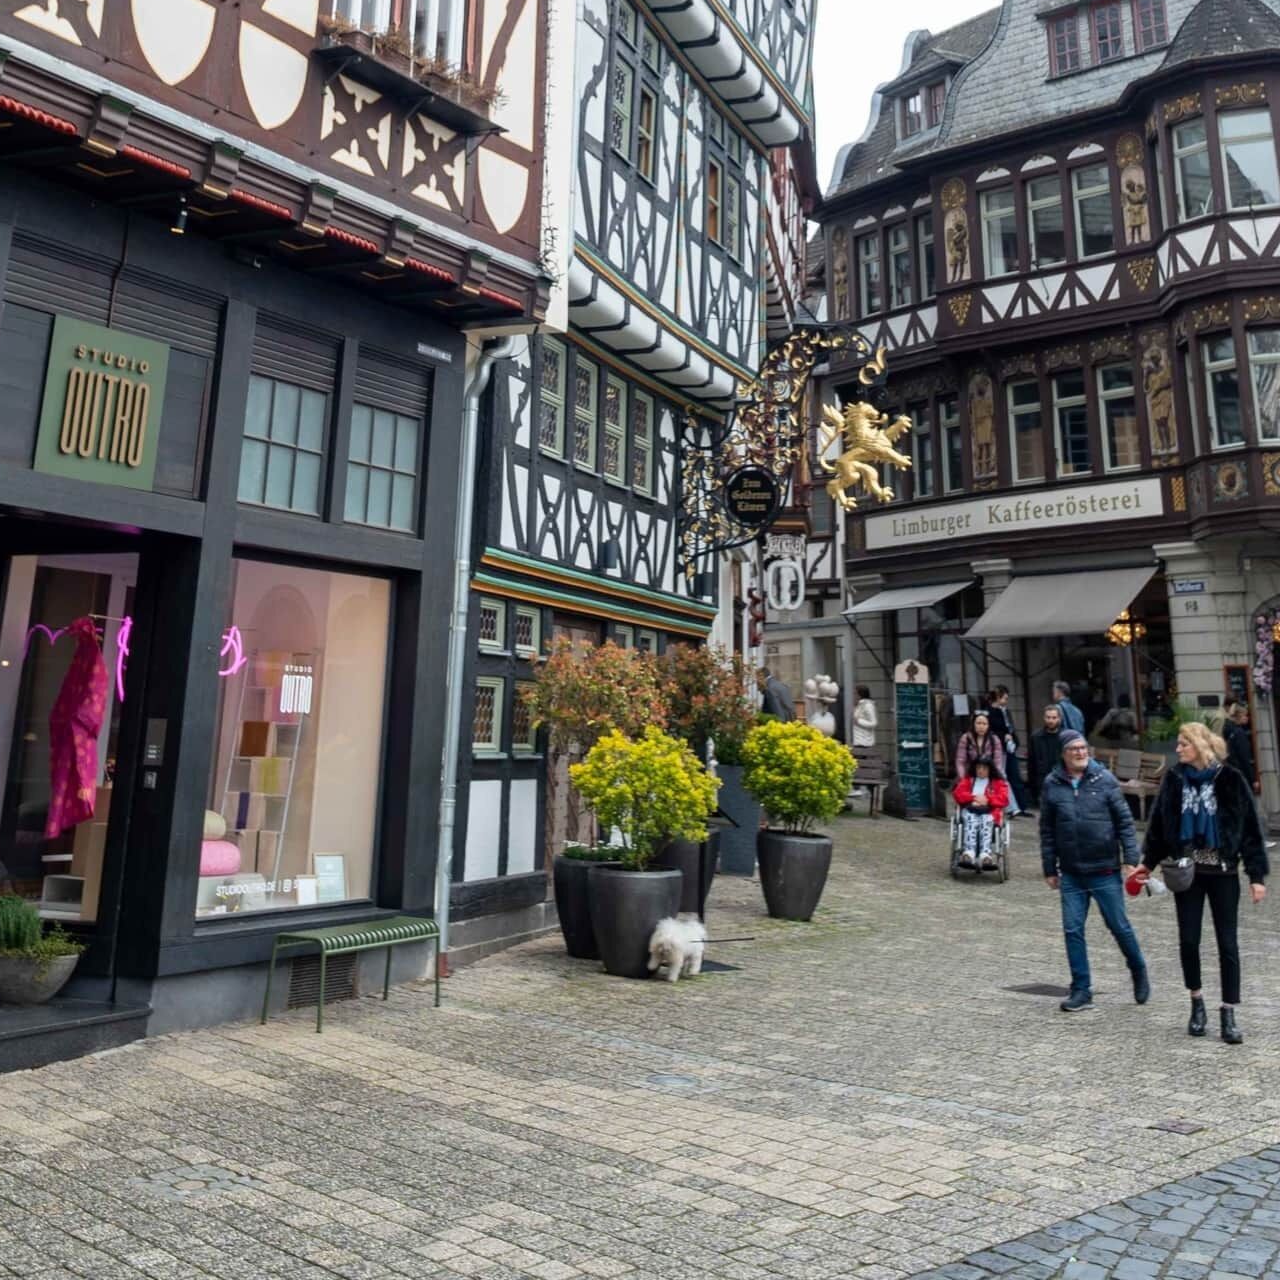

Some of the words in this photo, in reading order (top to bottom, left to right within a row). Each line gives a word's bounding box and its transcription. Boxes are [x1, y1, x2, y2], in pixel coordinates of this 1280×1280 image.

[77, 343, 150, 374] STUDIO
[60, 367, 150, 467] OUTRO
[892, 512, 971, 538] Limburger
[987, 487, 1142, 525] Kaffeerösterei
[280, 674, 312, 714] OUTRO
